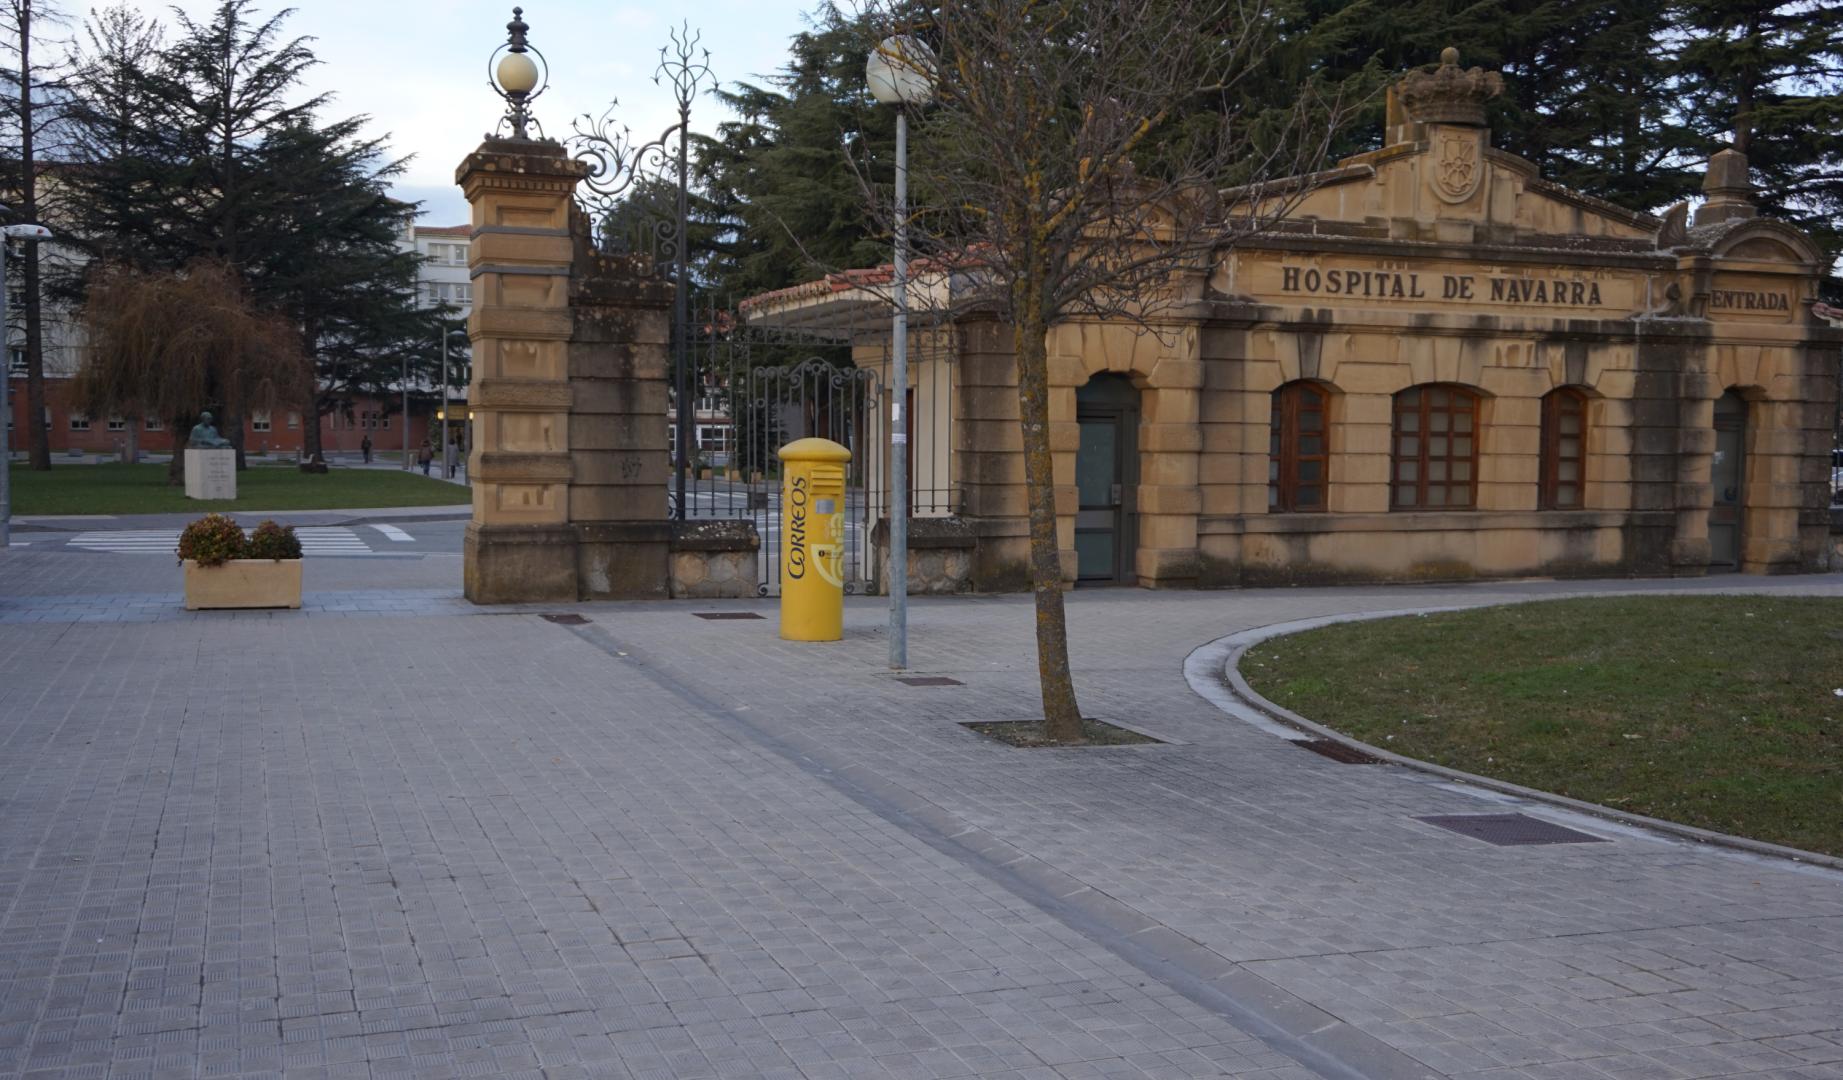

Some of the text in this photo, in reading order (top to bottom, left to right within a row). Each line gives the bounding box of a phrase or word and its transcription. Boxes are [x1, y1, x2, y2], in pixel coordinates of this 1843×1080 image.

[1282, 266, 1603, 305] HOSPITAL DE NAVARRA
[1711, 289, 1789, 311] ENTRADA
[787, 476, 807, 580] CORREOS
